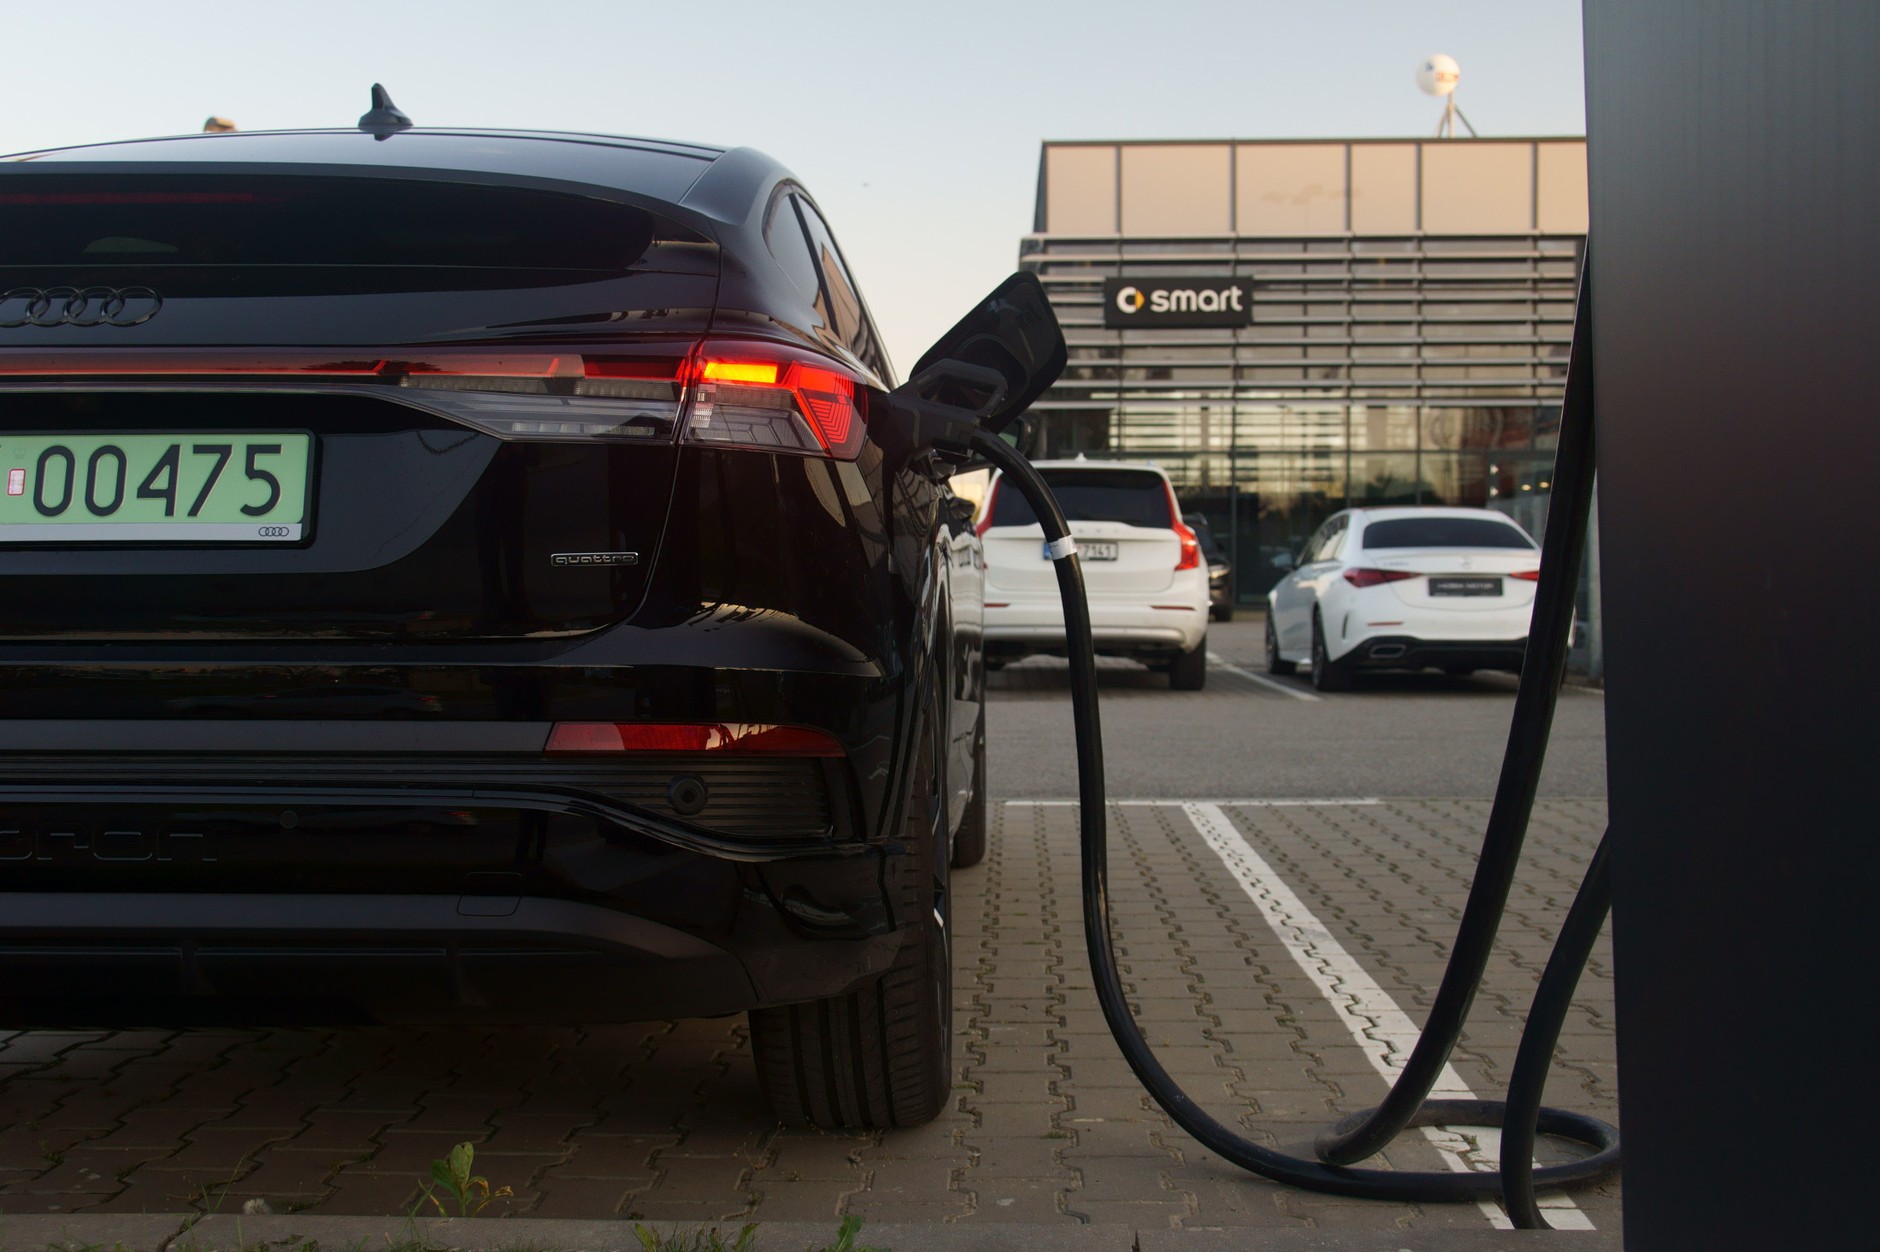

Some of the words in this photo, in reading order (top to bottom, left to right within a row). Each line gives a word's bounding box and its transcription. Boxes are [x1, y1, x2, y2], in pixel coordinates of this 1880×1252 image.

[1150, 285, 1243, 312] smart
[32, 443, 283, 517] 00475
[555, 554, 635, 565] quattro
